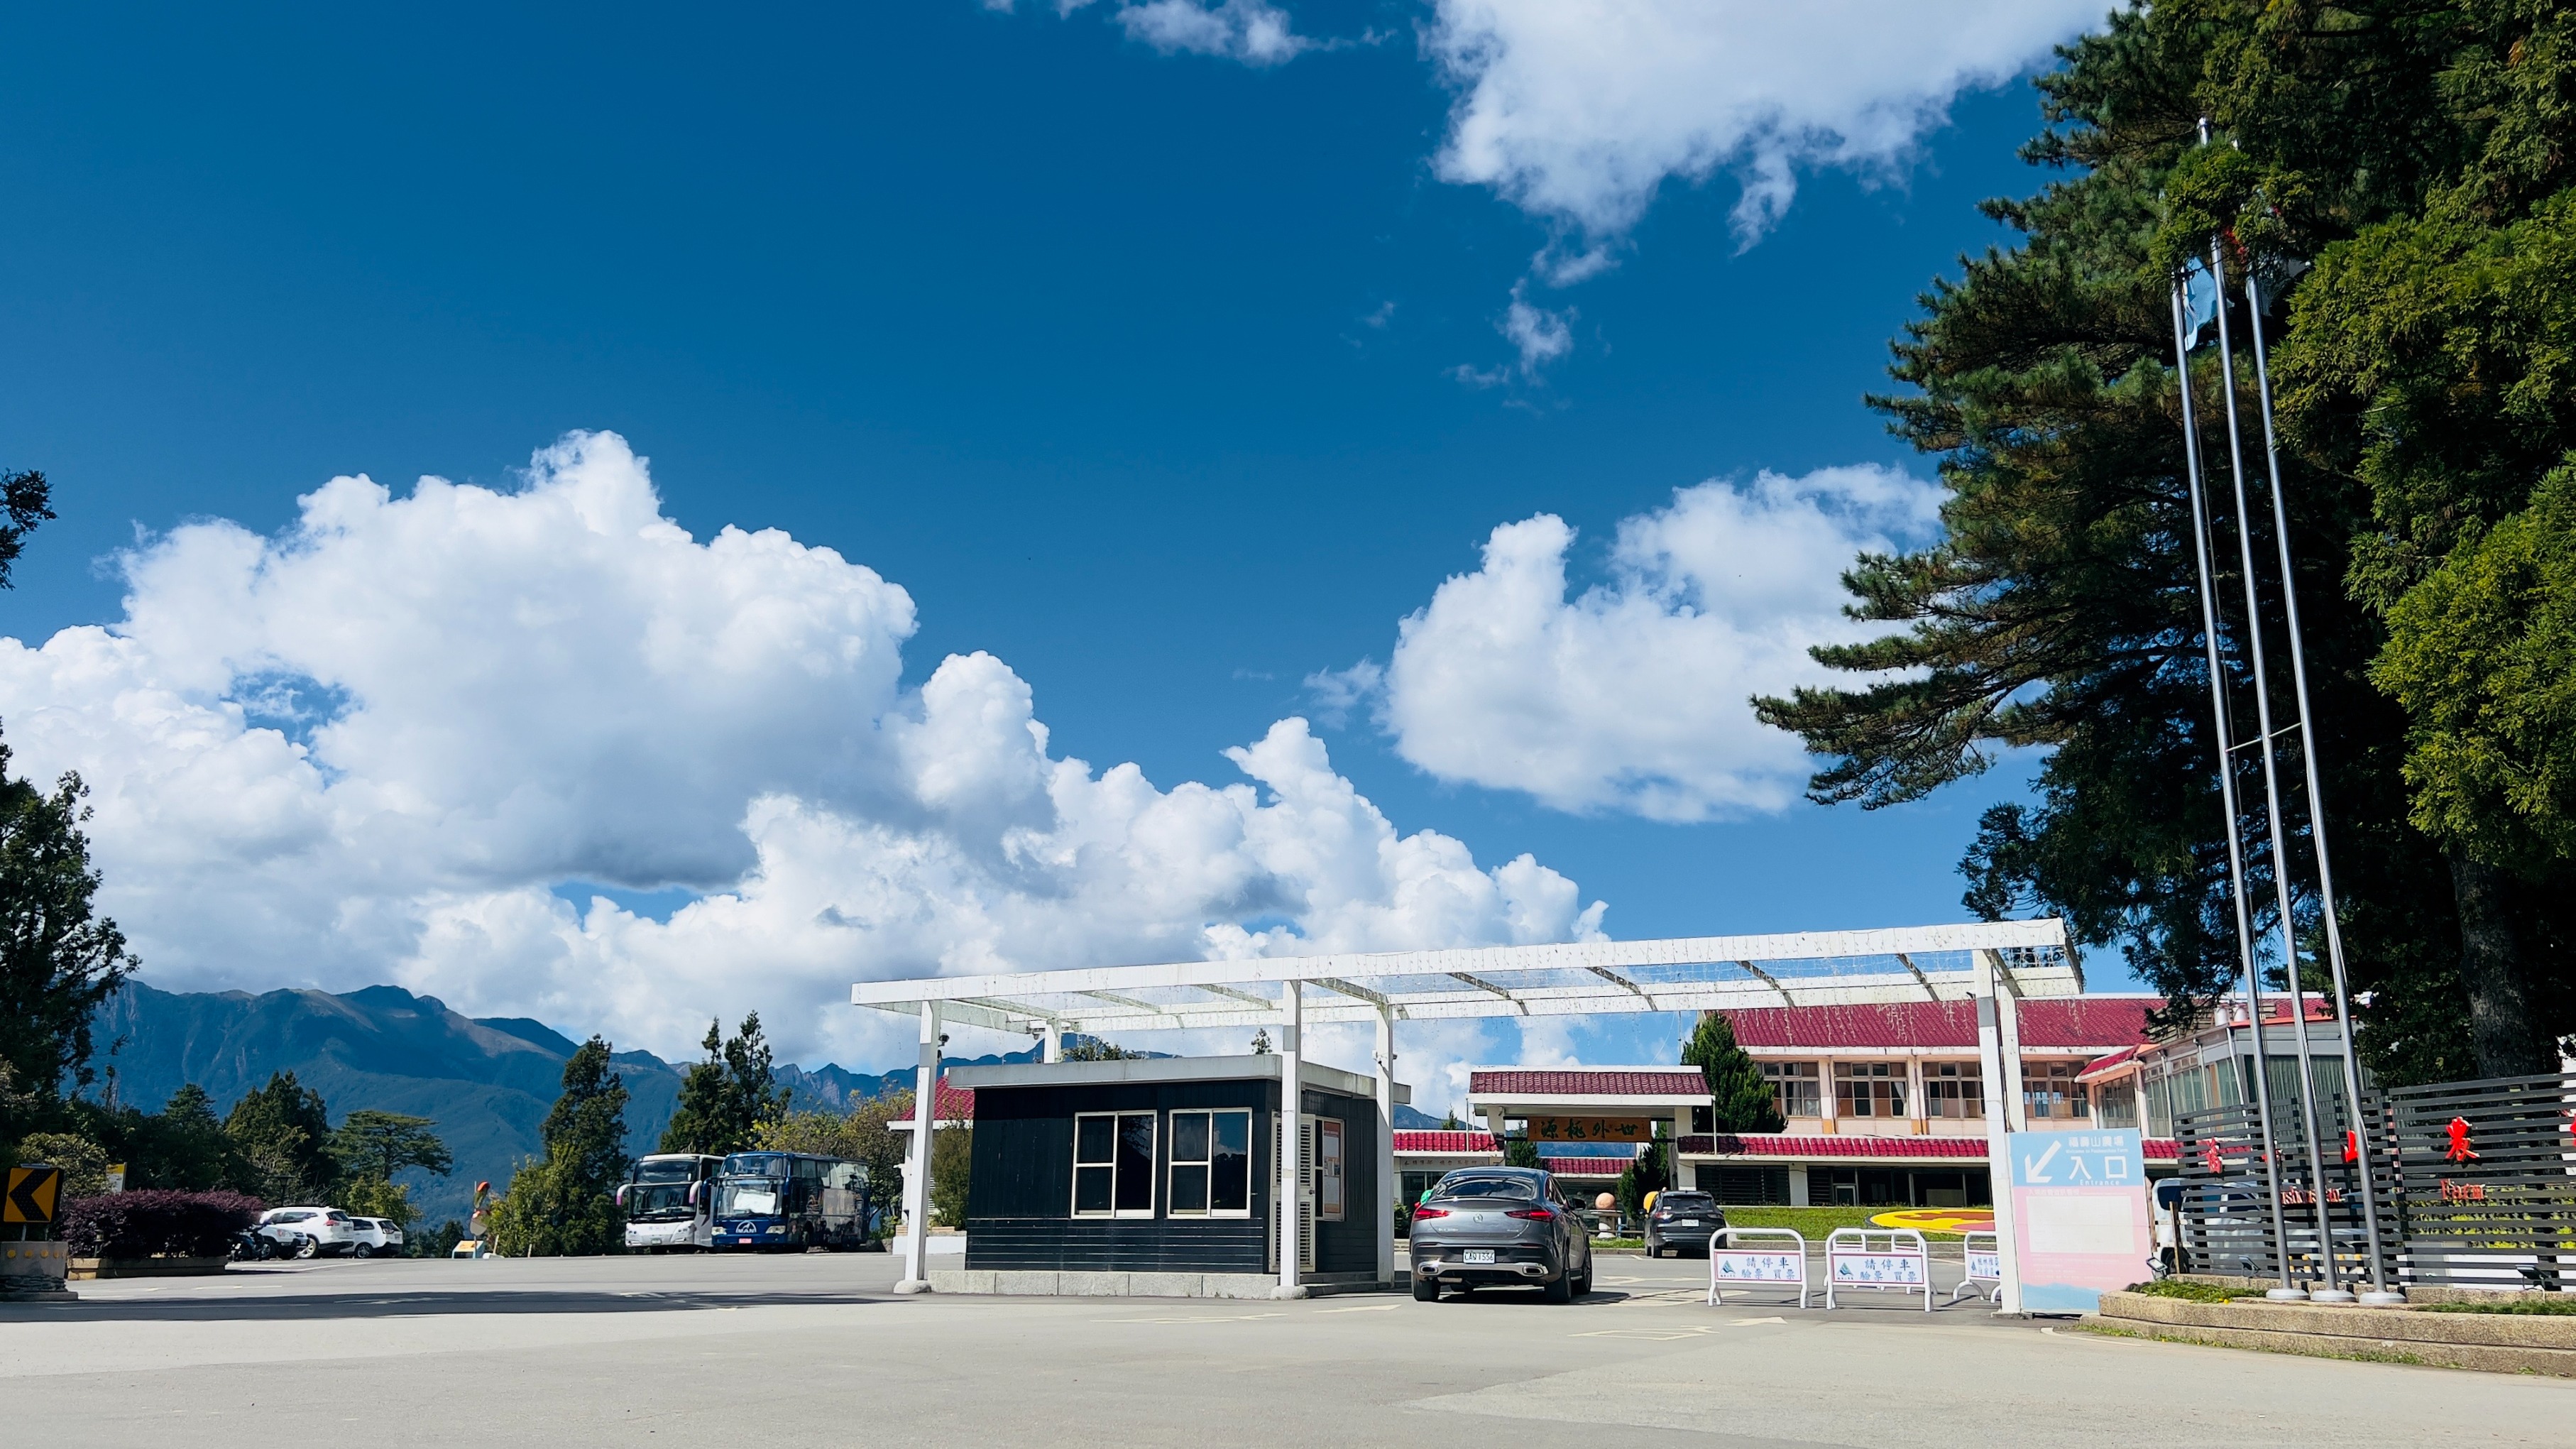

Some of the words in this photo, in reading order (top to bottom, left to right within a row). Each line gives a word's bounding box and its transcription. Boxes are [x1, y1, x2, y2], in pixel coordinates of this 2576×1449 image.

[2068, 1156, 2127, 1180] 入口
[1746, 1256, 1790, 1269] 請停車
[1864, 1258, 1910, 1271] 請停車
